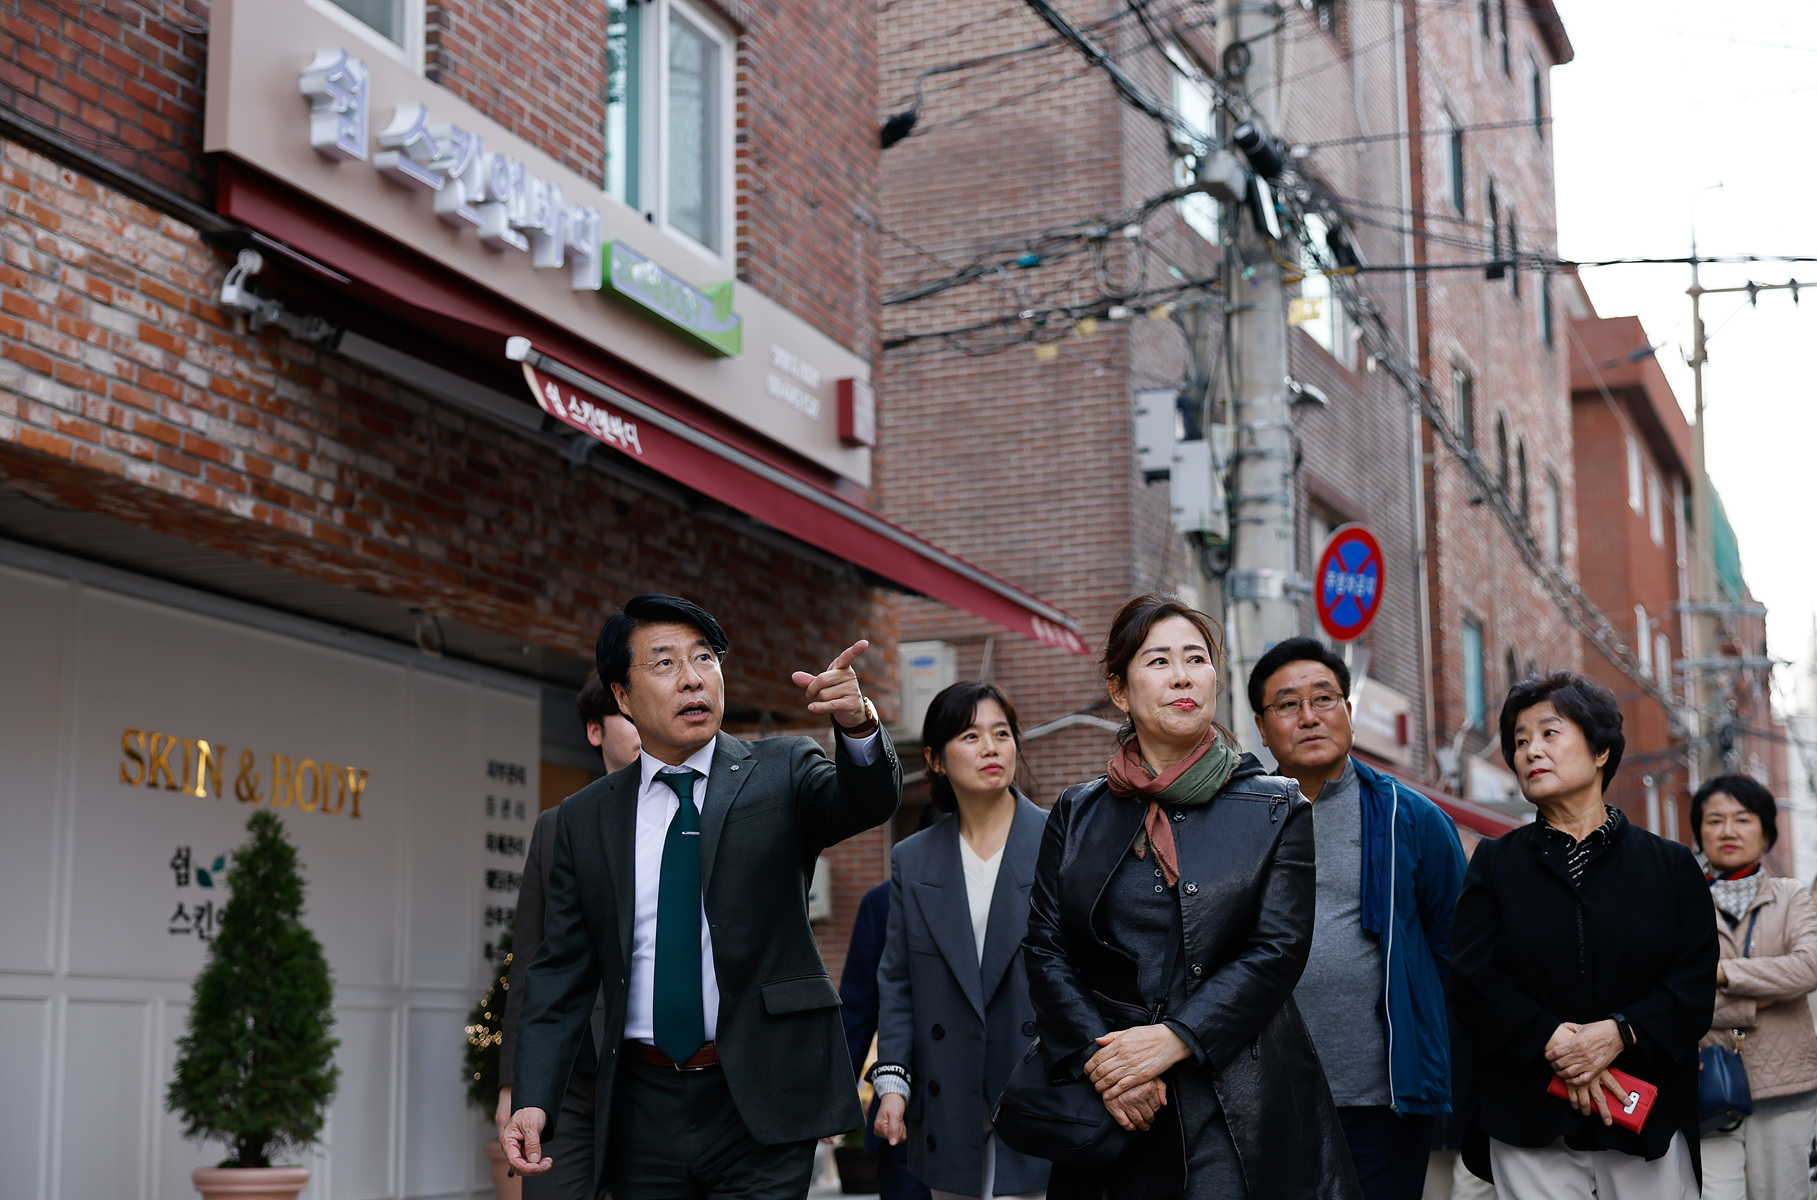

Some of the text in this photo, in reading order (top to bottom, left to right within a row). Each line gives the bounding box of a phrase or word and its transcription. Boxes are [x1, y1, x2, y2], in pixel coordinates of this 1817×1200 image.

[120, 727, 370, 819] SKIN & BODY
